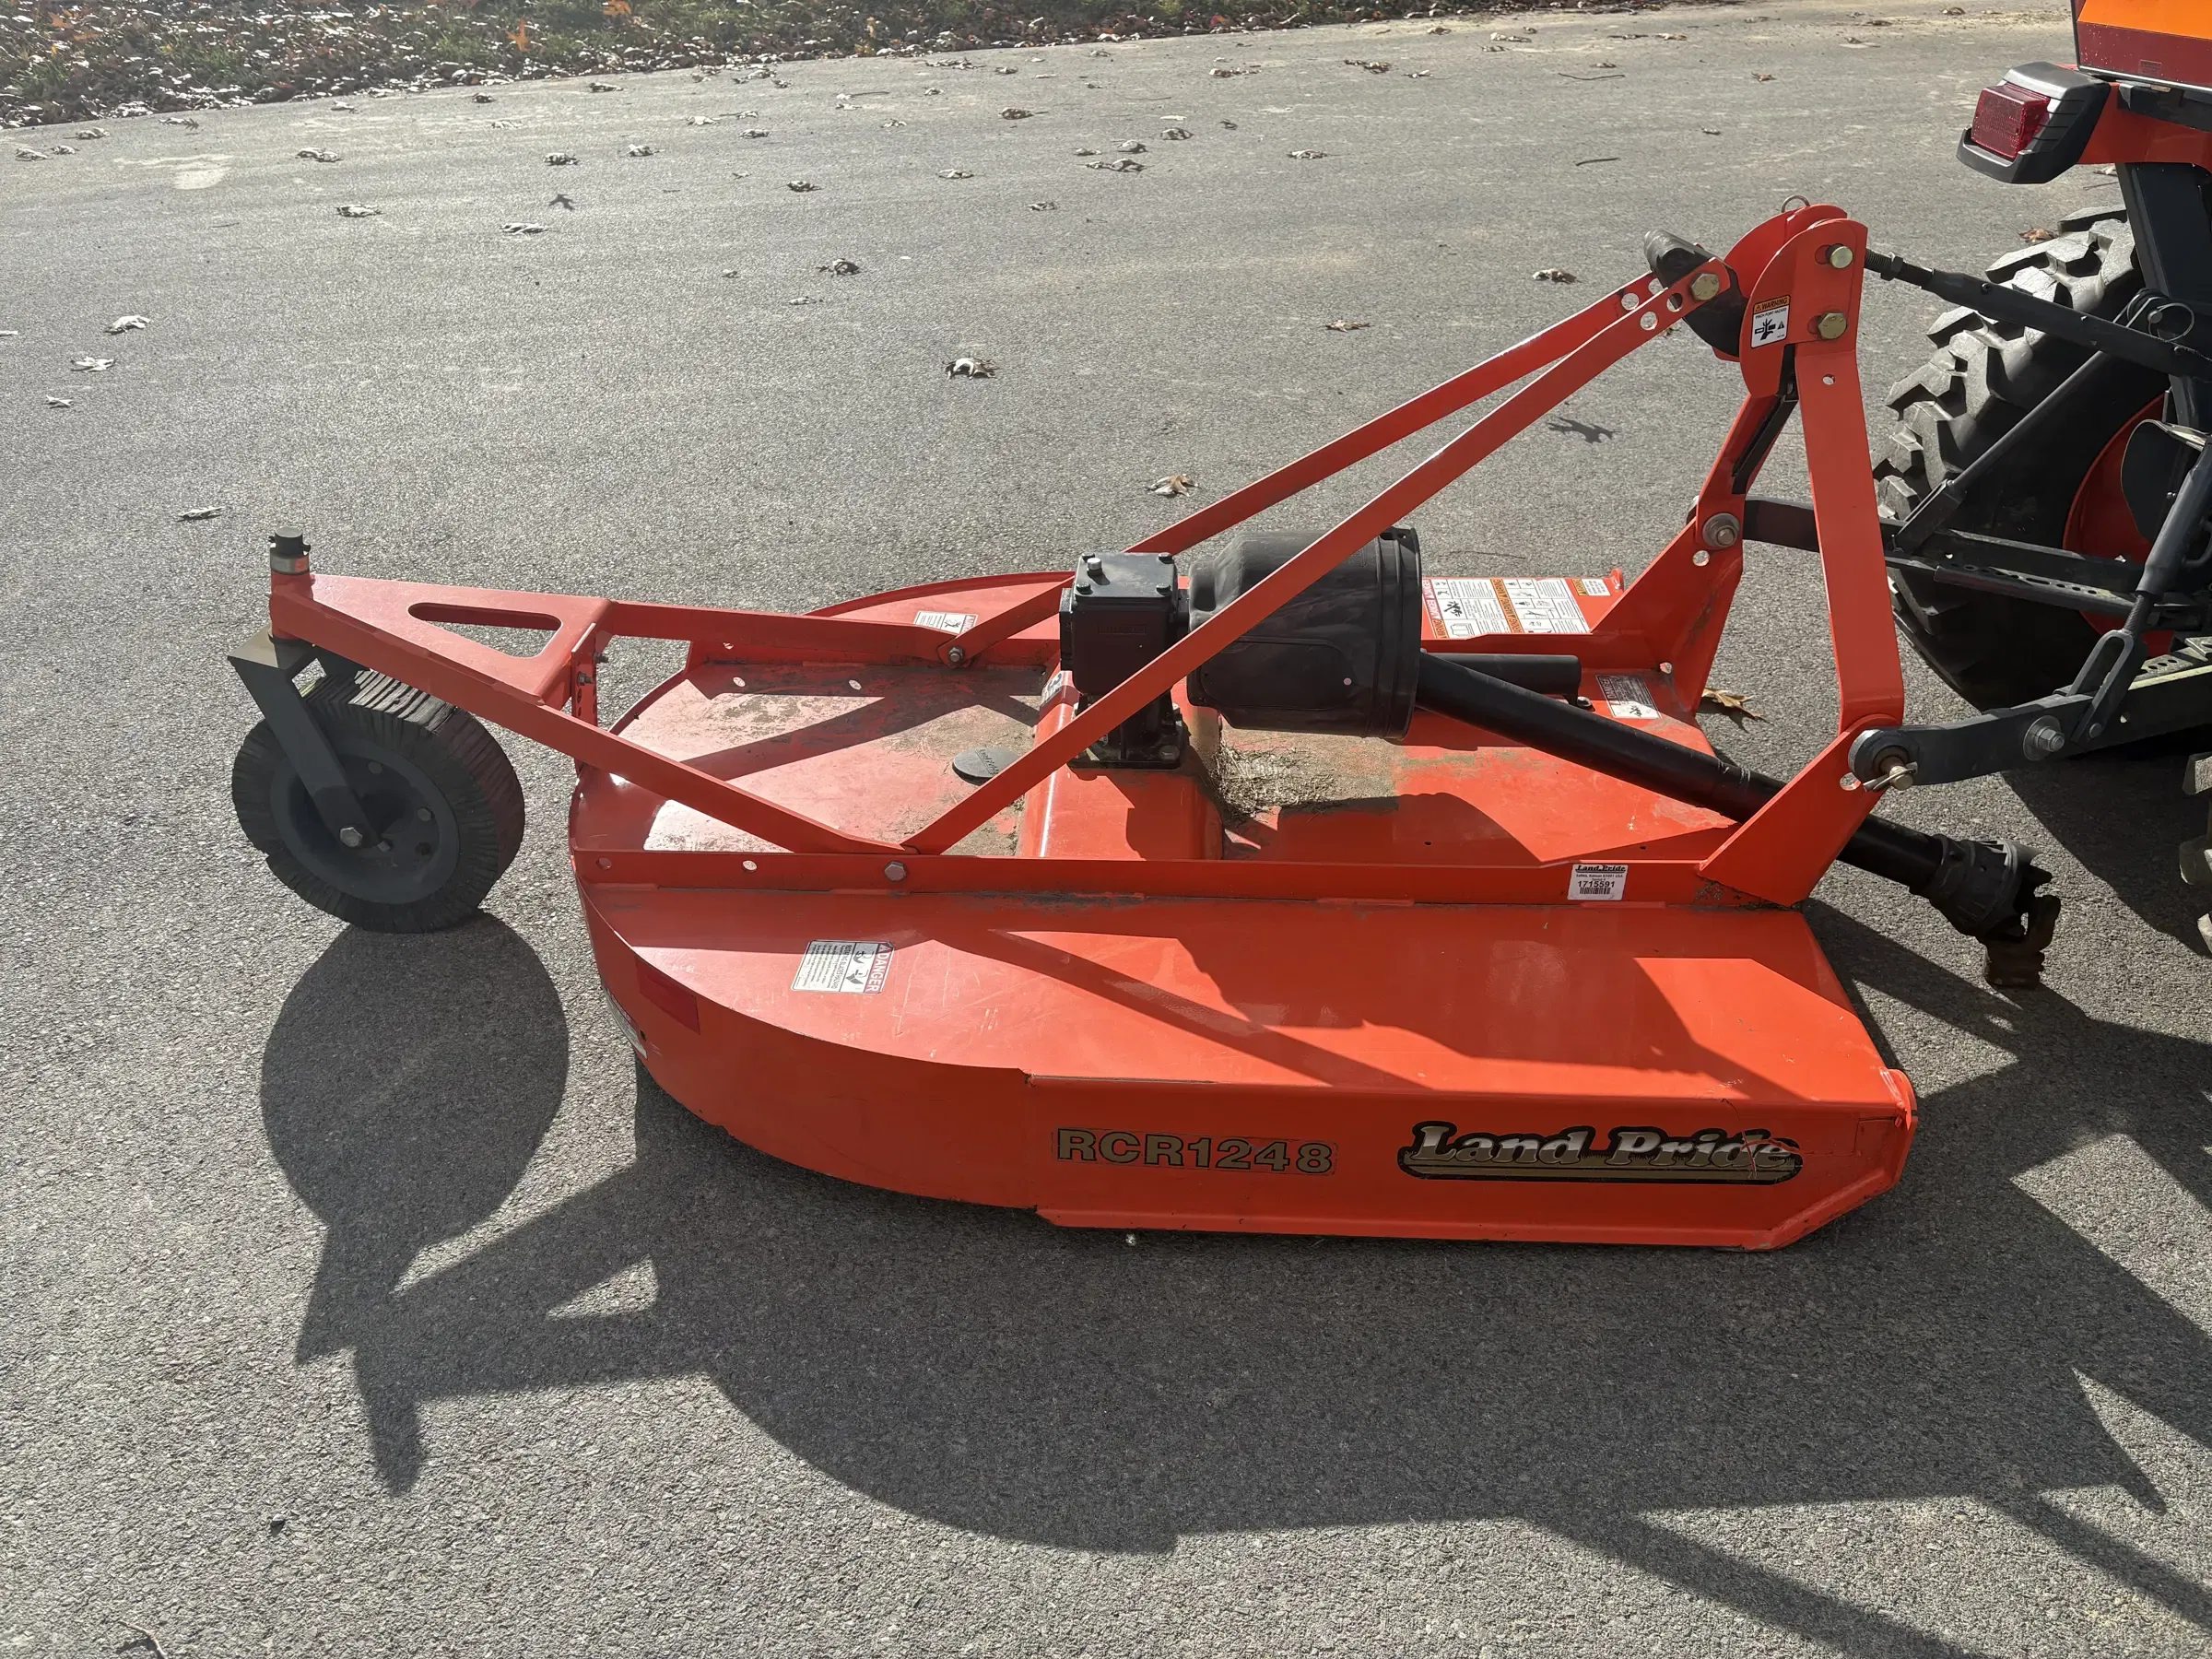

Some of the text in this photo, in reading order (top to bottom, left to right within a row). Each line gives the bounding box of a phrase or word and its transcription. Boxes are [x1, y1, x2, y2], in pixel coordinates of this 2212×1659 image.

[1761, 297, 1788, 310] WARNING
[865, 952, 888, 992] DANGER
[1057, 1127, 1333, 1174] RCR1248
[1408, 1123, 1793, 1169] Land Pride
